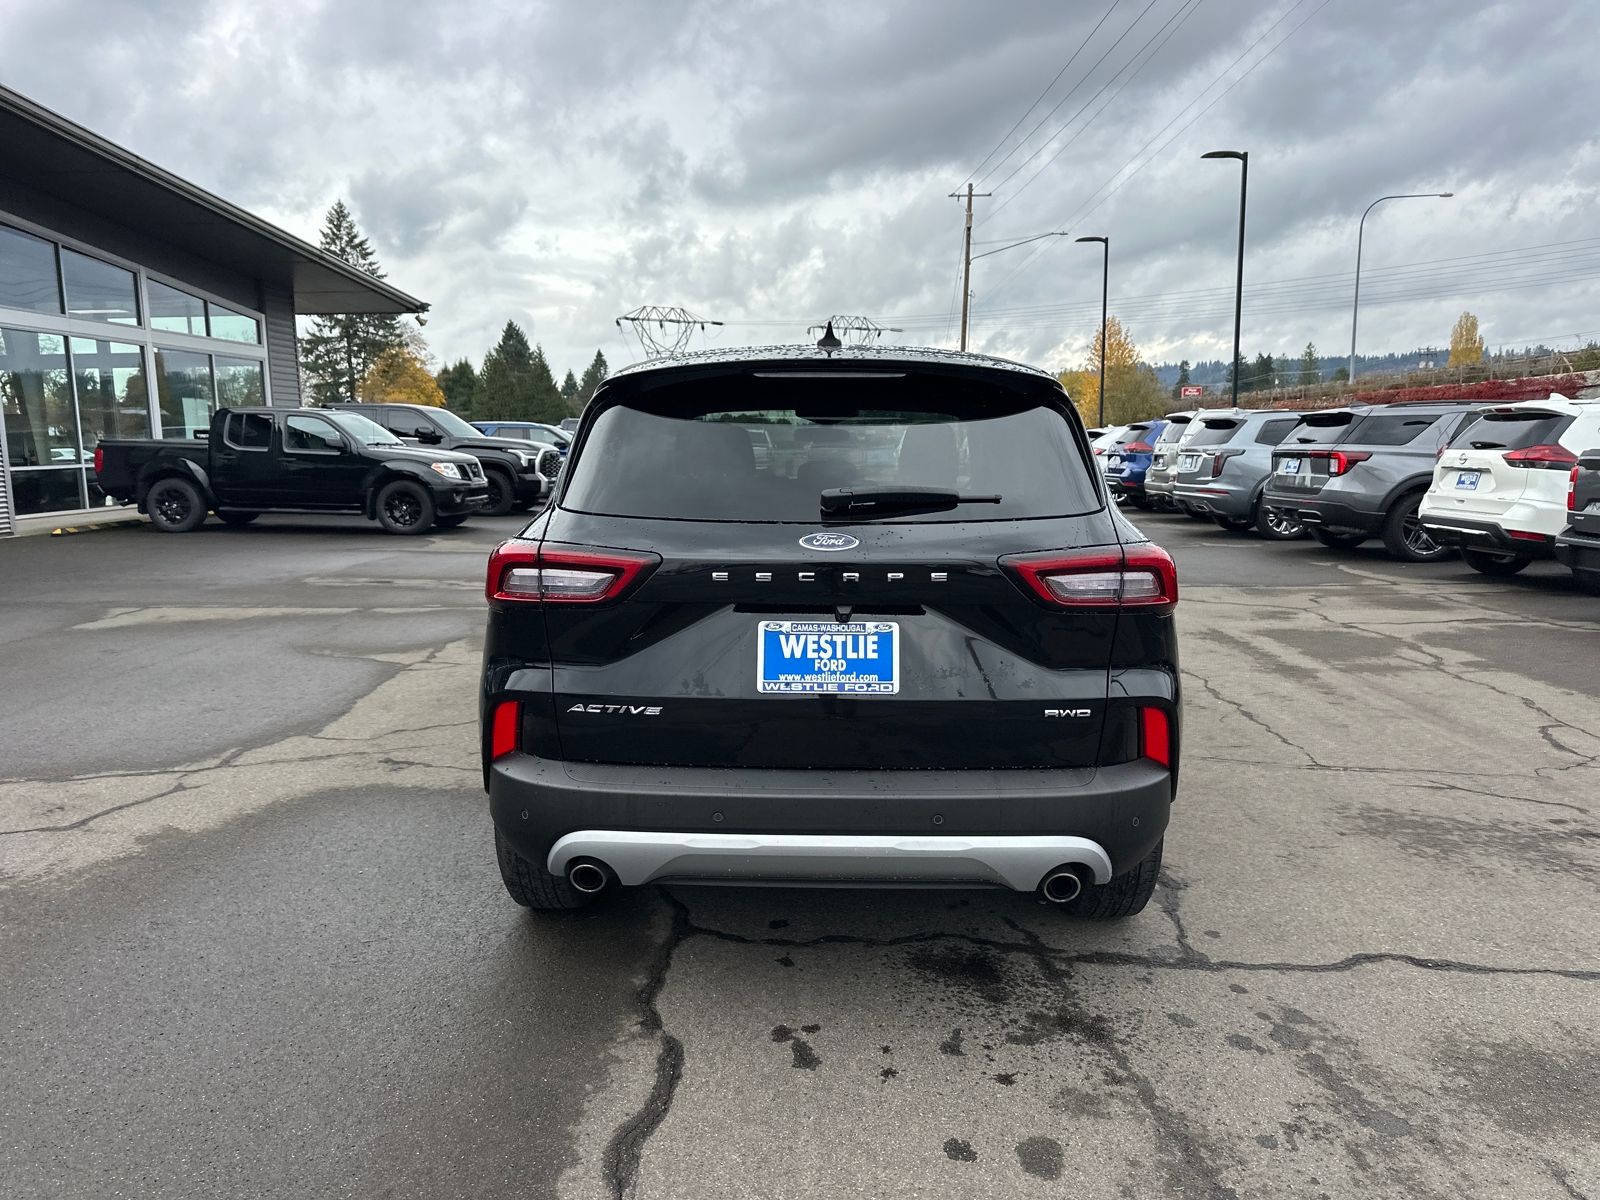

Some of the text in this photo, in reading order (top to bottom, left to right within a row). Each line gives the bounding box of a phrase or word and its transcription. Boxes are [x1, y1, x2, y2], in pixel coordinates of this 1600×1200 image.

[712, 572, 948, 582] ESCAPE
[791, 623, 865, 632] CAMAS-WASHOUGAL
[779, 635, 878, 659] WESTLIE
[814, 659, 847, 671] FORD
[778, 672, 878, 682] www.westlieford.com
[764, 682, 893, 692] WESTLIE FORD
[566, 703, 664, 715] ACTIVE
[1044, 709, 1091, 718] AWD
